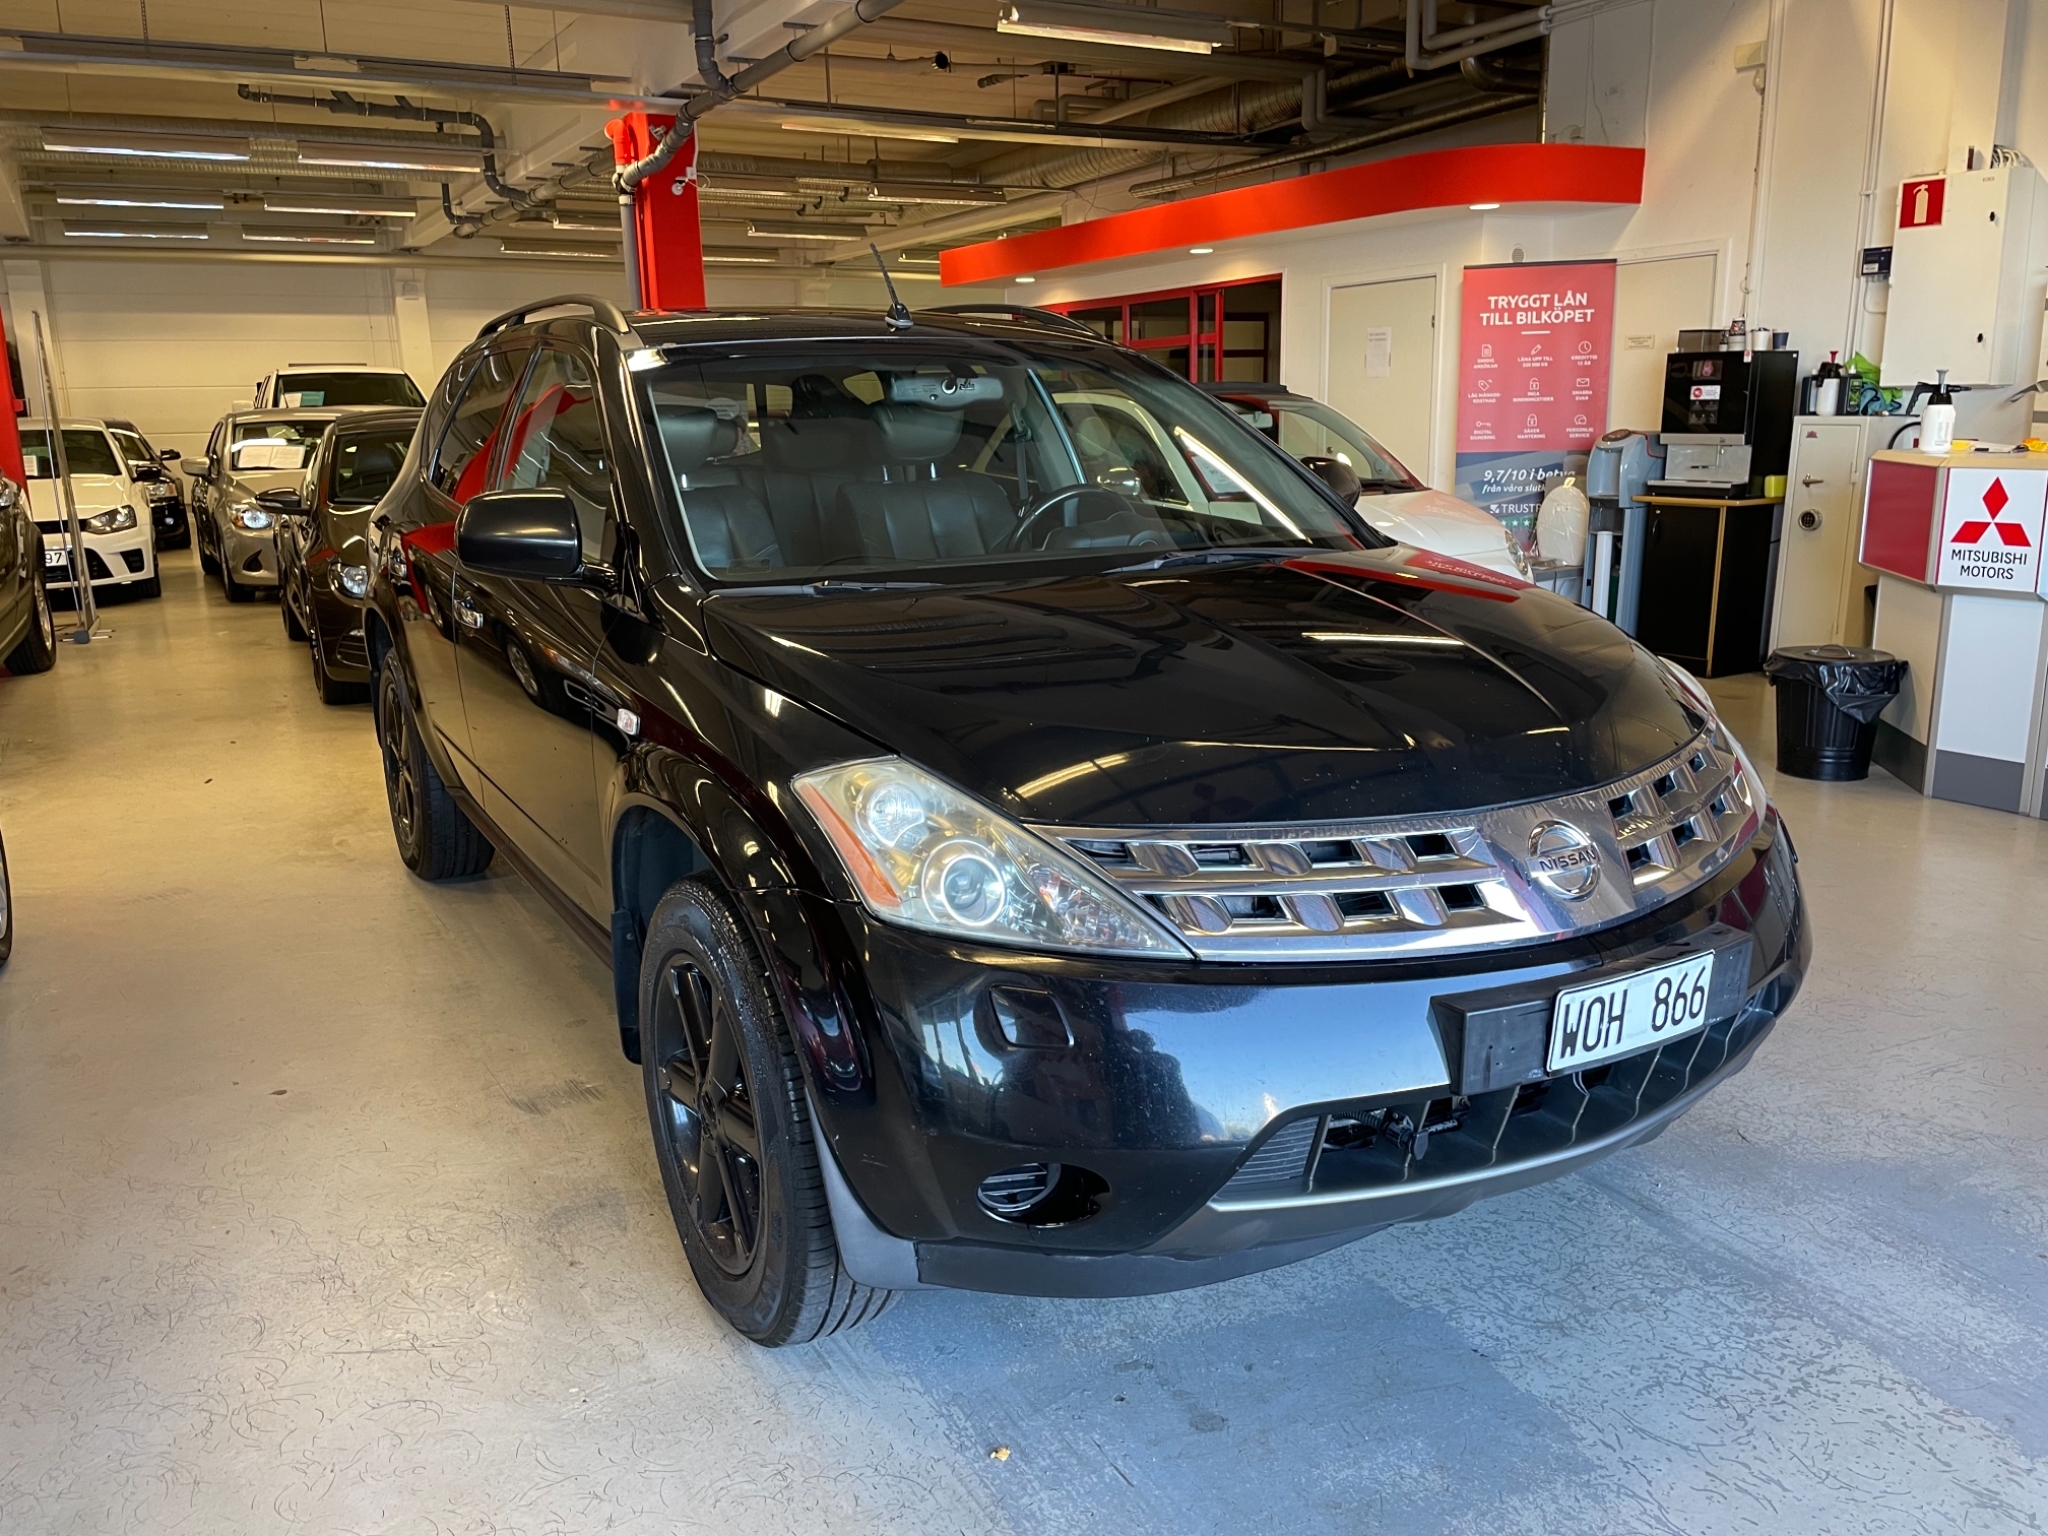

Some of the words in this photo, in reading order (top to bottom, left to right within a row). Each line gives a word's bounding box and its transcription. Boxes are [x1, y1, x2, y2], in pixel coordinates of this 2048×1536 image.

[1488, 294, 1550, 309] TRYGGT
[1554, 290, 1587, 307] LÅN
[1480, 312, 1513, 326] TILL
[1516, 307, 1595, 325] BILKÖPET
[1483, 468, 1527, 484] 9,7/10
[1482, 483, 1502, 495] från
[1503, 483, 1523, 493] våra
[1951, 549, 2028, 566] MITSUBISHI
[1959, 565, 2014, 580] MOTORS
[1539, 849, 1598, 871] NISSAN
[1560, 988, 1628, 1060] WOH
[1651, 965, 1706, 1033] 866
